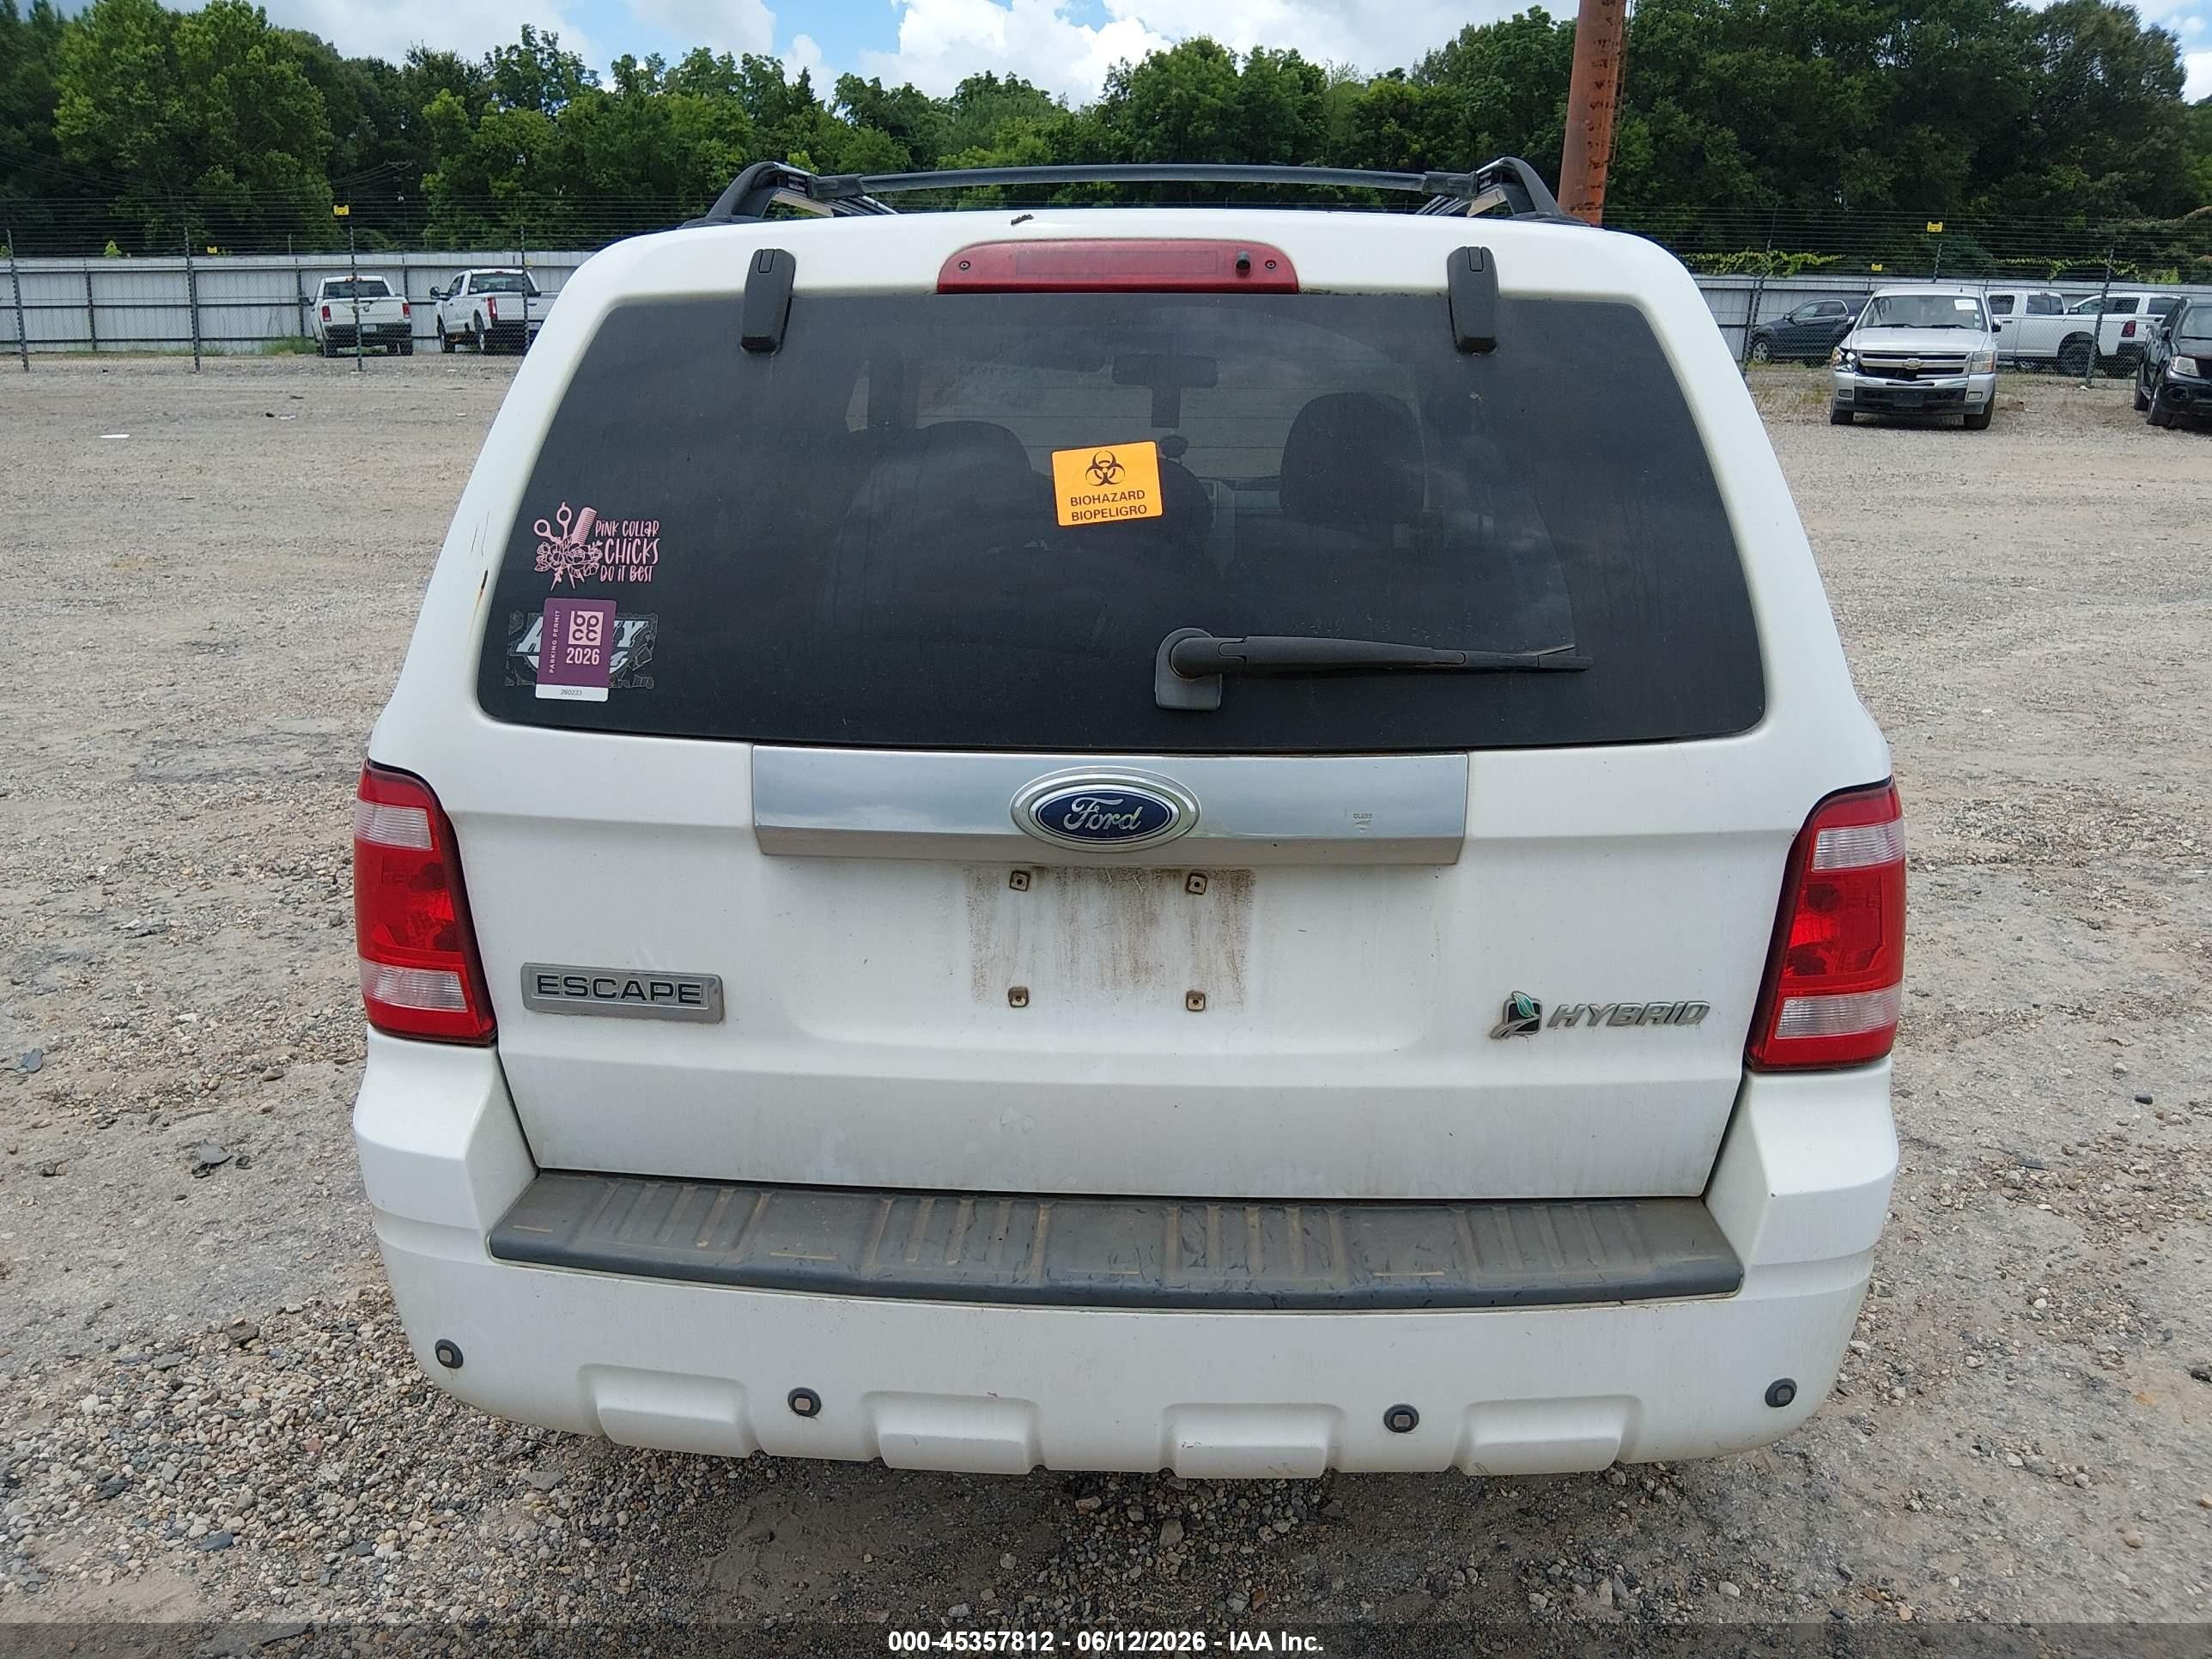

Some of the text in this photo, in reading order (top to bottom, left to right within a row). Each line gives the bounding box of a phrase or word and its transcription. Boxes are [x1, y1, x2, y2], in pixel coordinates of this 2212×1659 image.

[1070, 489, 1146, 507] BIOHAZARD
[1071, 504, 1147, 522] BIOPELIGRO
[600, 565, 615, 582] DO
[549, 610, 561, 673] PARKING PERMIT
[566, 647, 600, 665] 2026
[1063, 797, 1144, 830] Ford
[536, 973, 703, 1005] ESCAPE
[1547, 1000, 1711, 1027] HYBRID
